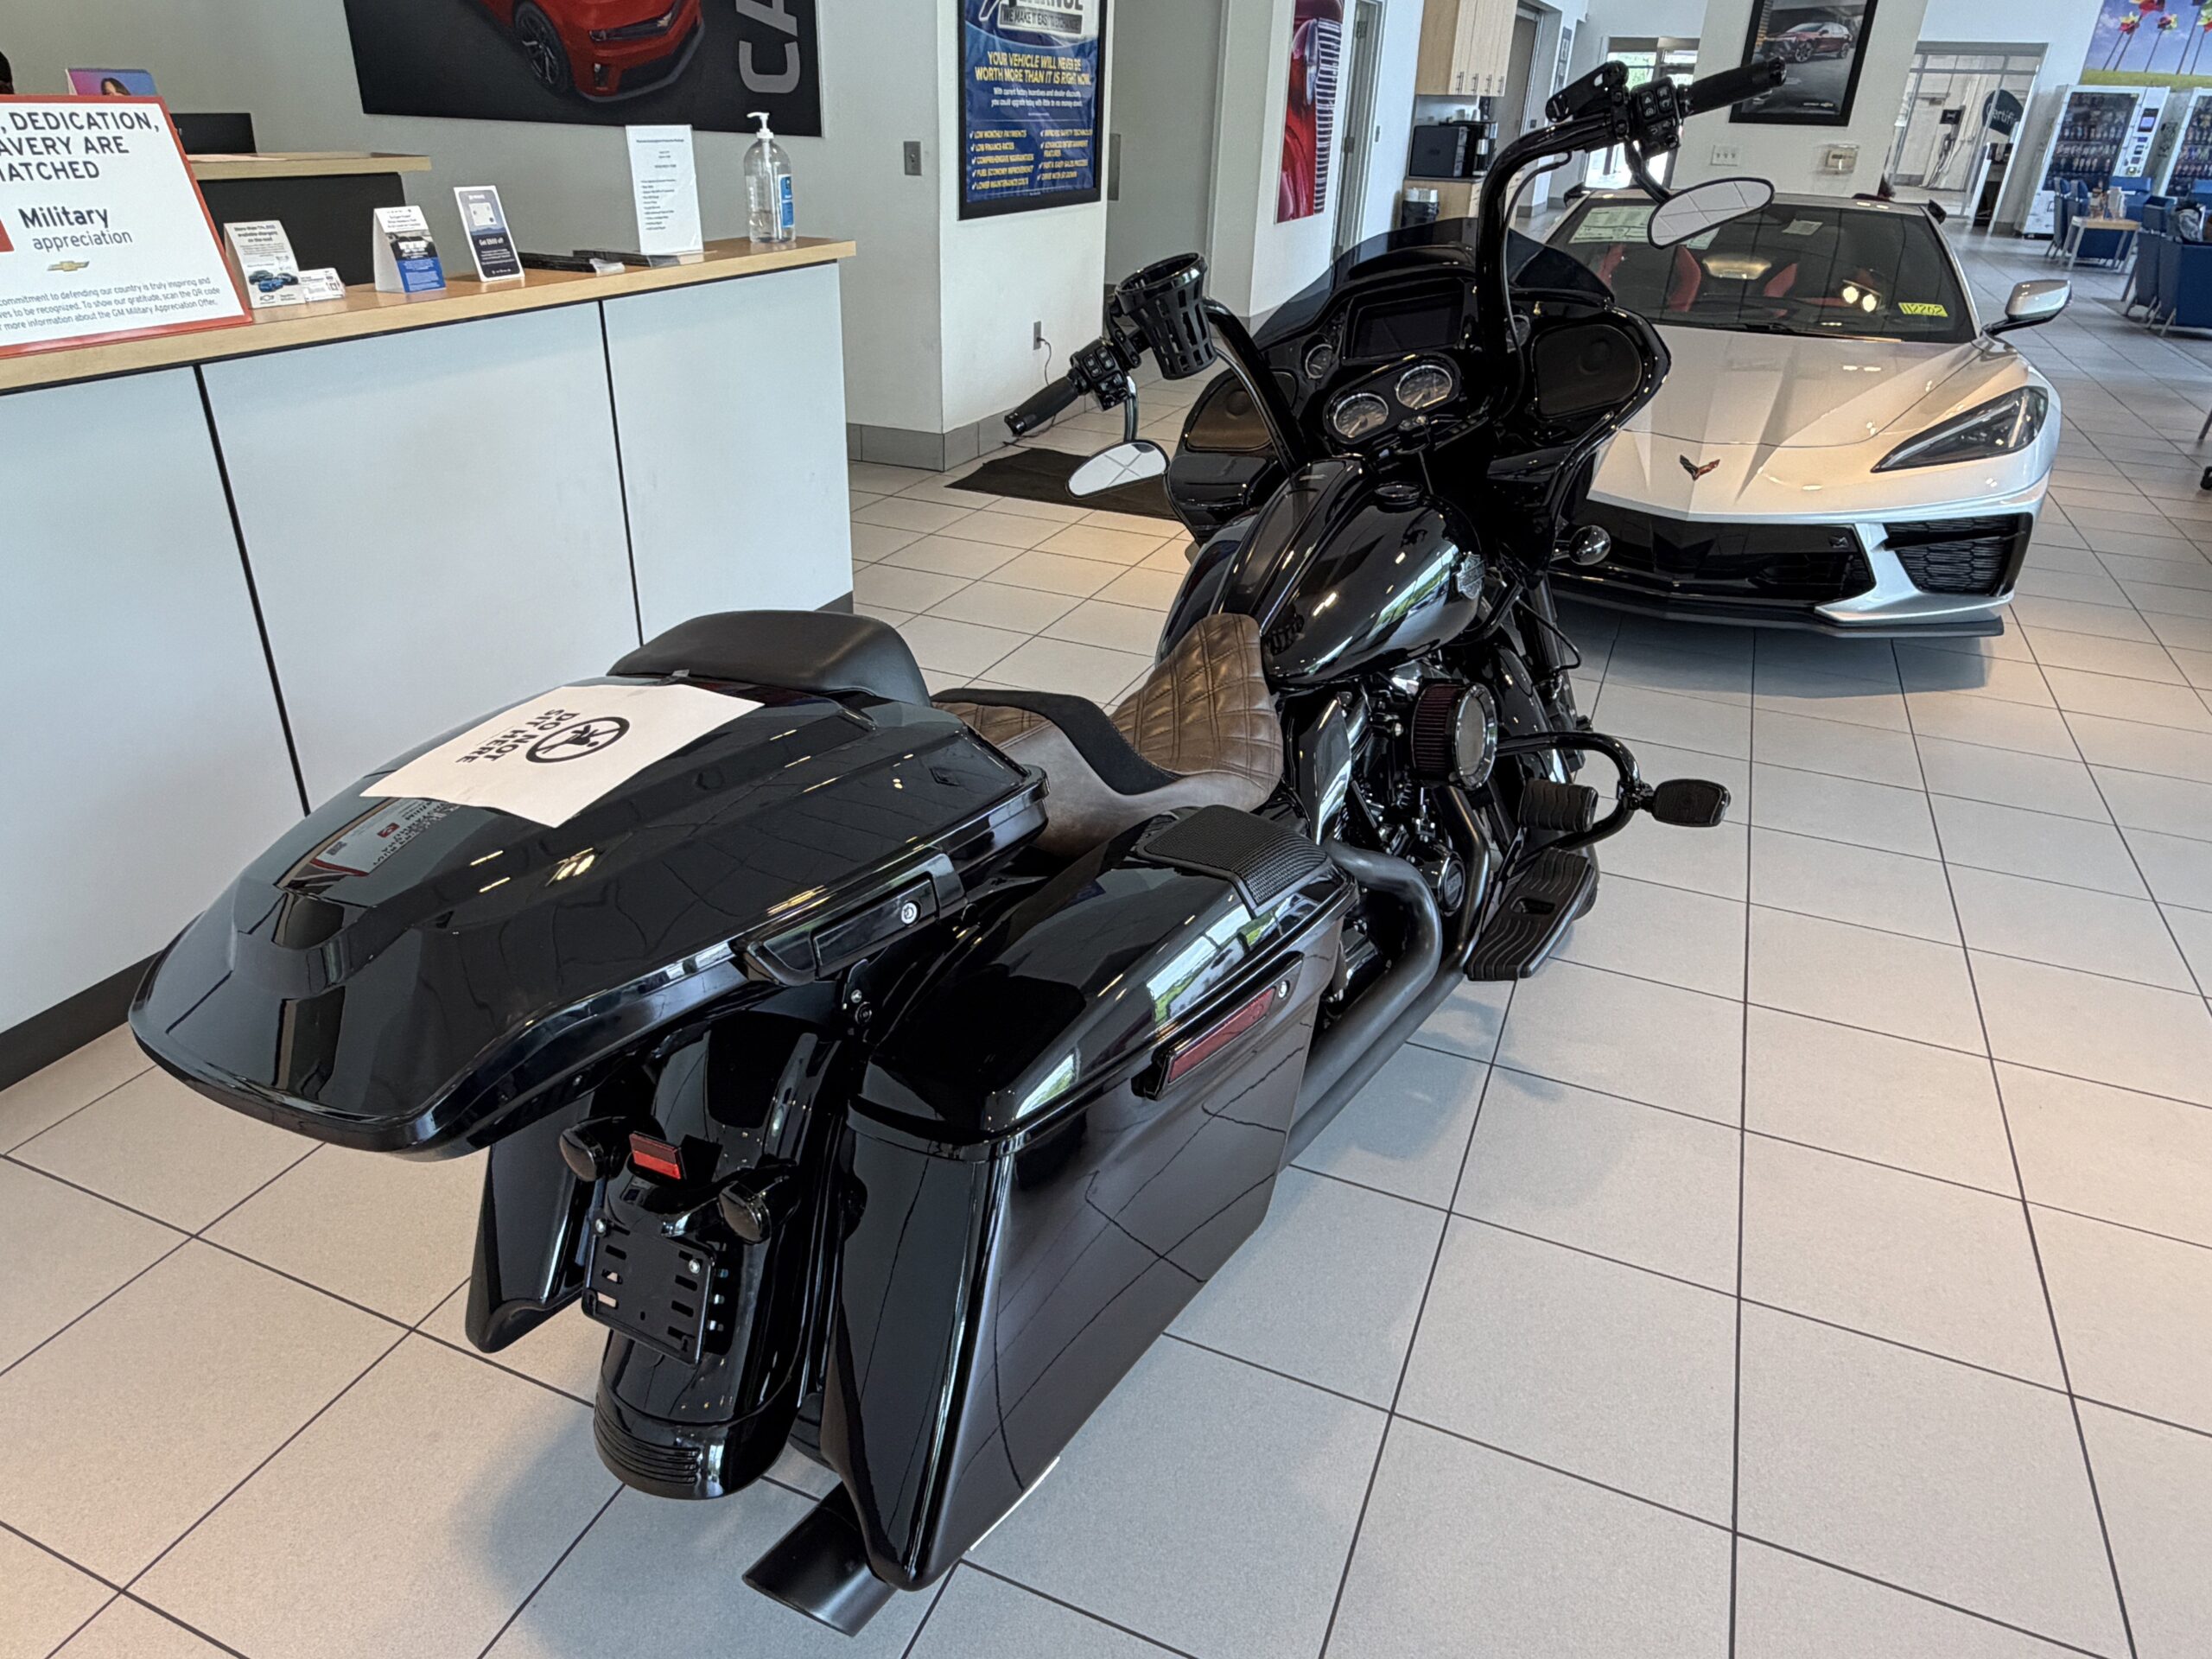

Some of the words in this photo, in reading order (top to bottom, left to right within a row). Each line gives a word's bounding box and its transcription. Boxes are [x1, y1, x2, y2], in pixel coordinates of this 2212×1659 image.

[1014, 10, 1032, 23] MAKE
[987, 50, 1008, 66] YOUR
[1008, 52, 1039, 68] VEHICLE
[1040, 54, 1056, 69] WILL
[975, 66, 1003, 81] WORTH
[1004, 67, 1023, 82] MORE
[1024, 69, 1044, 84] THAN
[1045, 70, 1052, 84] IT
[1053, 71, 1060, 84] IS
[9, 111, 159, 132] DEDICATION,
[84, 136, 130, 155] ARE
[18, 206, 109, 229] Military
[32, 229, 133, 253] appreciation
[60, 289, 99, 300] defending
[100, 287, 112, 296] our
[114, 284, 142, 294] country
[149, 282, 166, 290] truly
[168, 279, 197, 289] inspiring
[198, 276, 211, 285] and
[13, 308, 23, 317] to
[23, 307, 35, 316] be
[82, 300, 92, 308] To
[93, 298, 112, 308] show
[162, 291, 179, 300] scan
[179, 289, 191, 298] the
[192, 288, 203, 296] QR
[204, 286, 220, 296] code
[3, 321, 27, 330] more
[28, 315, 73, 327] information
[74, 311, 98, 321] about
[98, 309, 111, 319] the
[111, 308, 124, 317] GM
[125, 305, 154, 315] Military
[154, 300, 197, 313] Appreciation
[525, 709, 564, 728] SIT
[538, 713, 581, 730] DO
[455, 729, 527, 763] HERE
[484, 734, 539, 761] NOT
